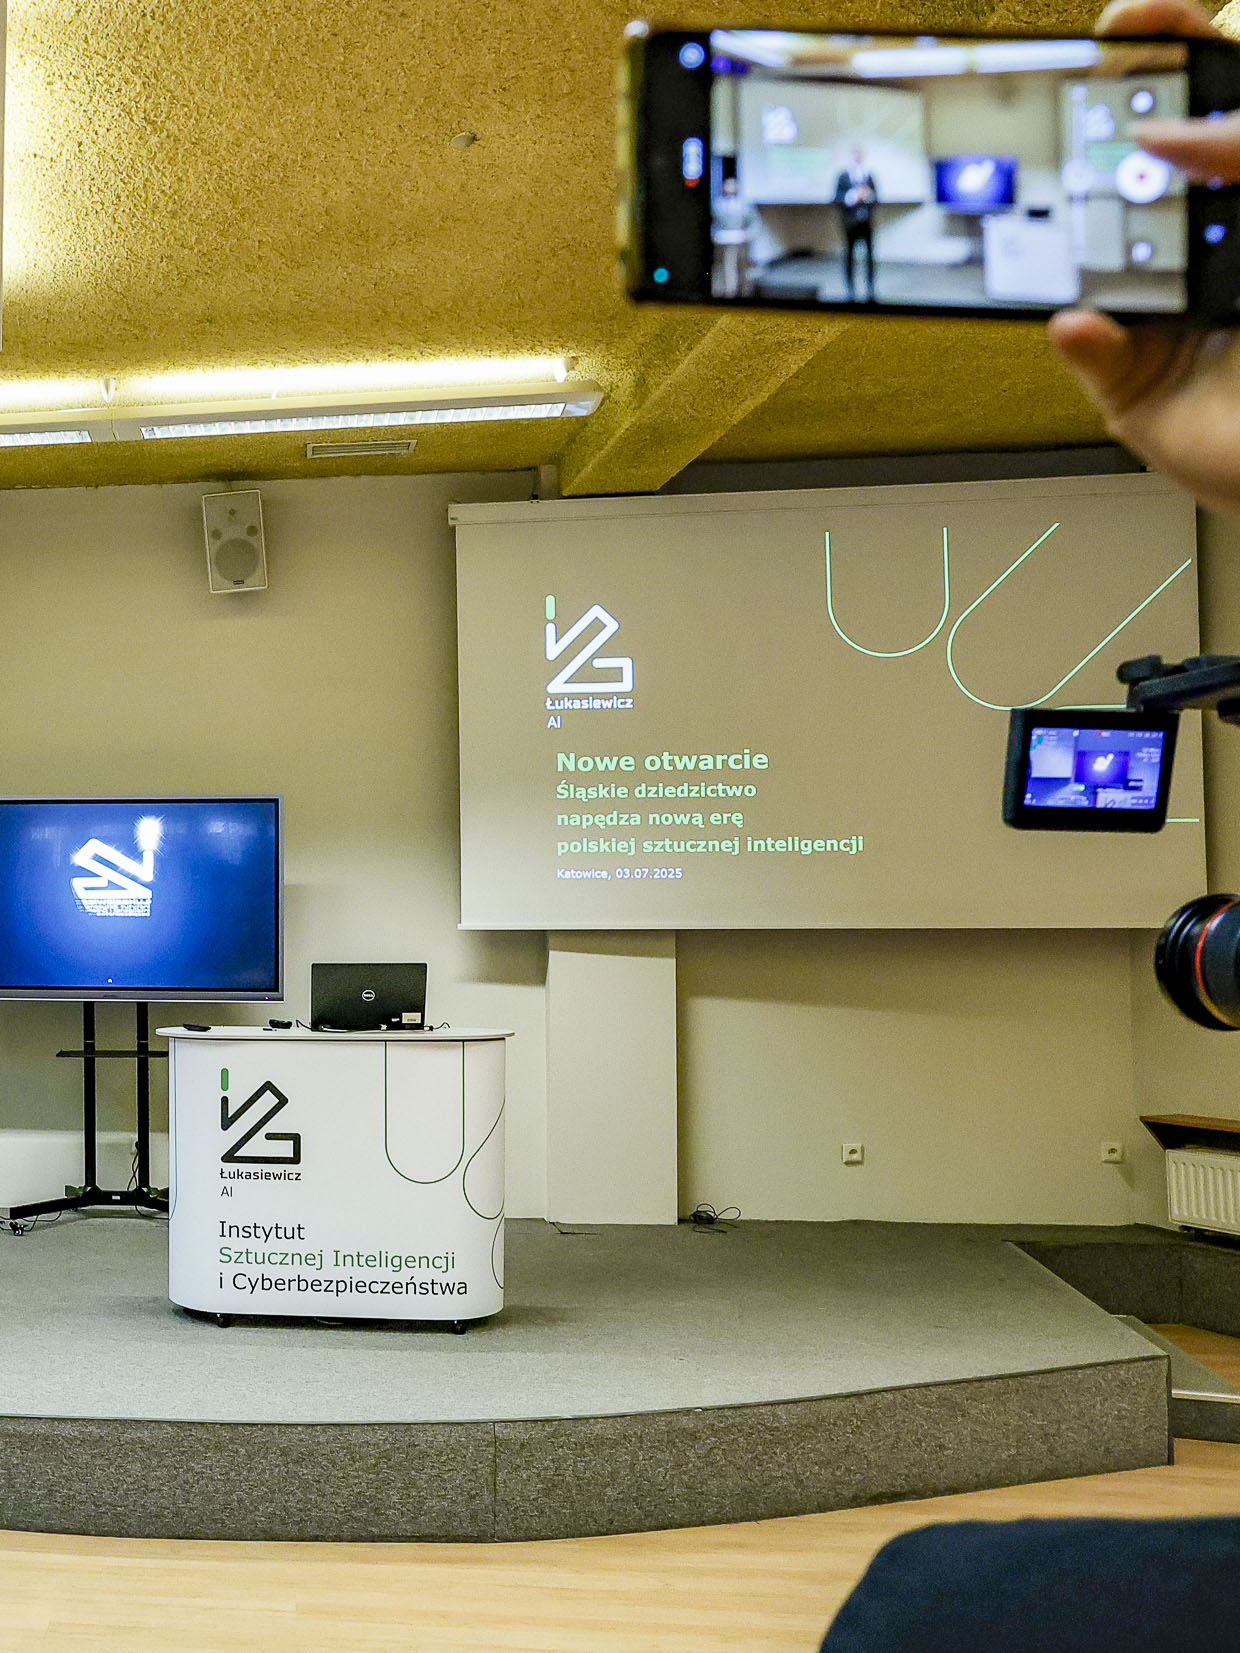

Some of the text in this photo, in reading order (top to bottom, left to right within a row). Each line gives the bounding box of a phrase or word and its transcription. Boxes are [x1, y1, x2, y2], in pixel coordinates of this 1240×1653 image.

[546, 696, 634, 710] Łukasiewicz
[547, 716, 561, 728] AI
[557, 749, 769, 771] Nowe otwarcie
[556, 780, 757, 801] Śląskie dziedzictwo
[557, 811, 744, 828] napędza nową erę
[557, 836, 864, 855] polskiej sztucznej inteligencji
[557, 868, 683, 879] Katowice, 03.07.2025
[220, 1168, 302, 1181] Łukasiewicz
[221, 1186, 233, 1197] AI
[219, 1221, 305, 1243] Instytut
[219, 1247, 456, 1273] Sztucznej Inteligencji
[218, 1272, 468, 1297] i Cyberbezpieczeństwa
